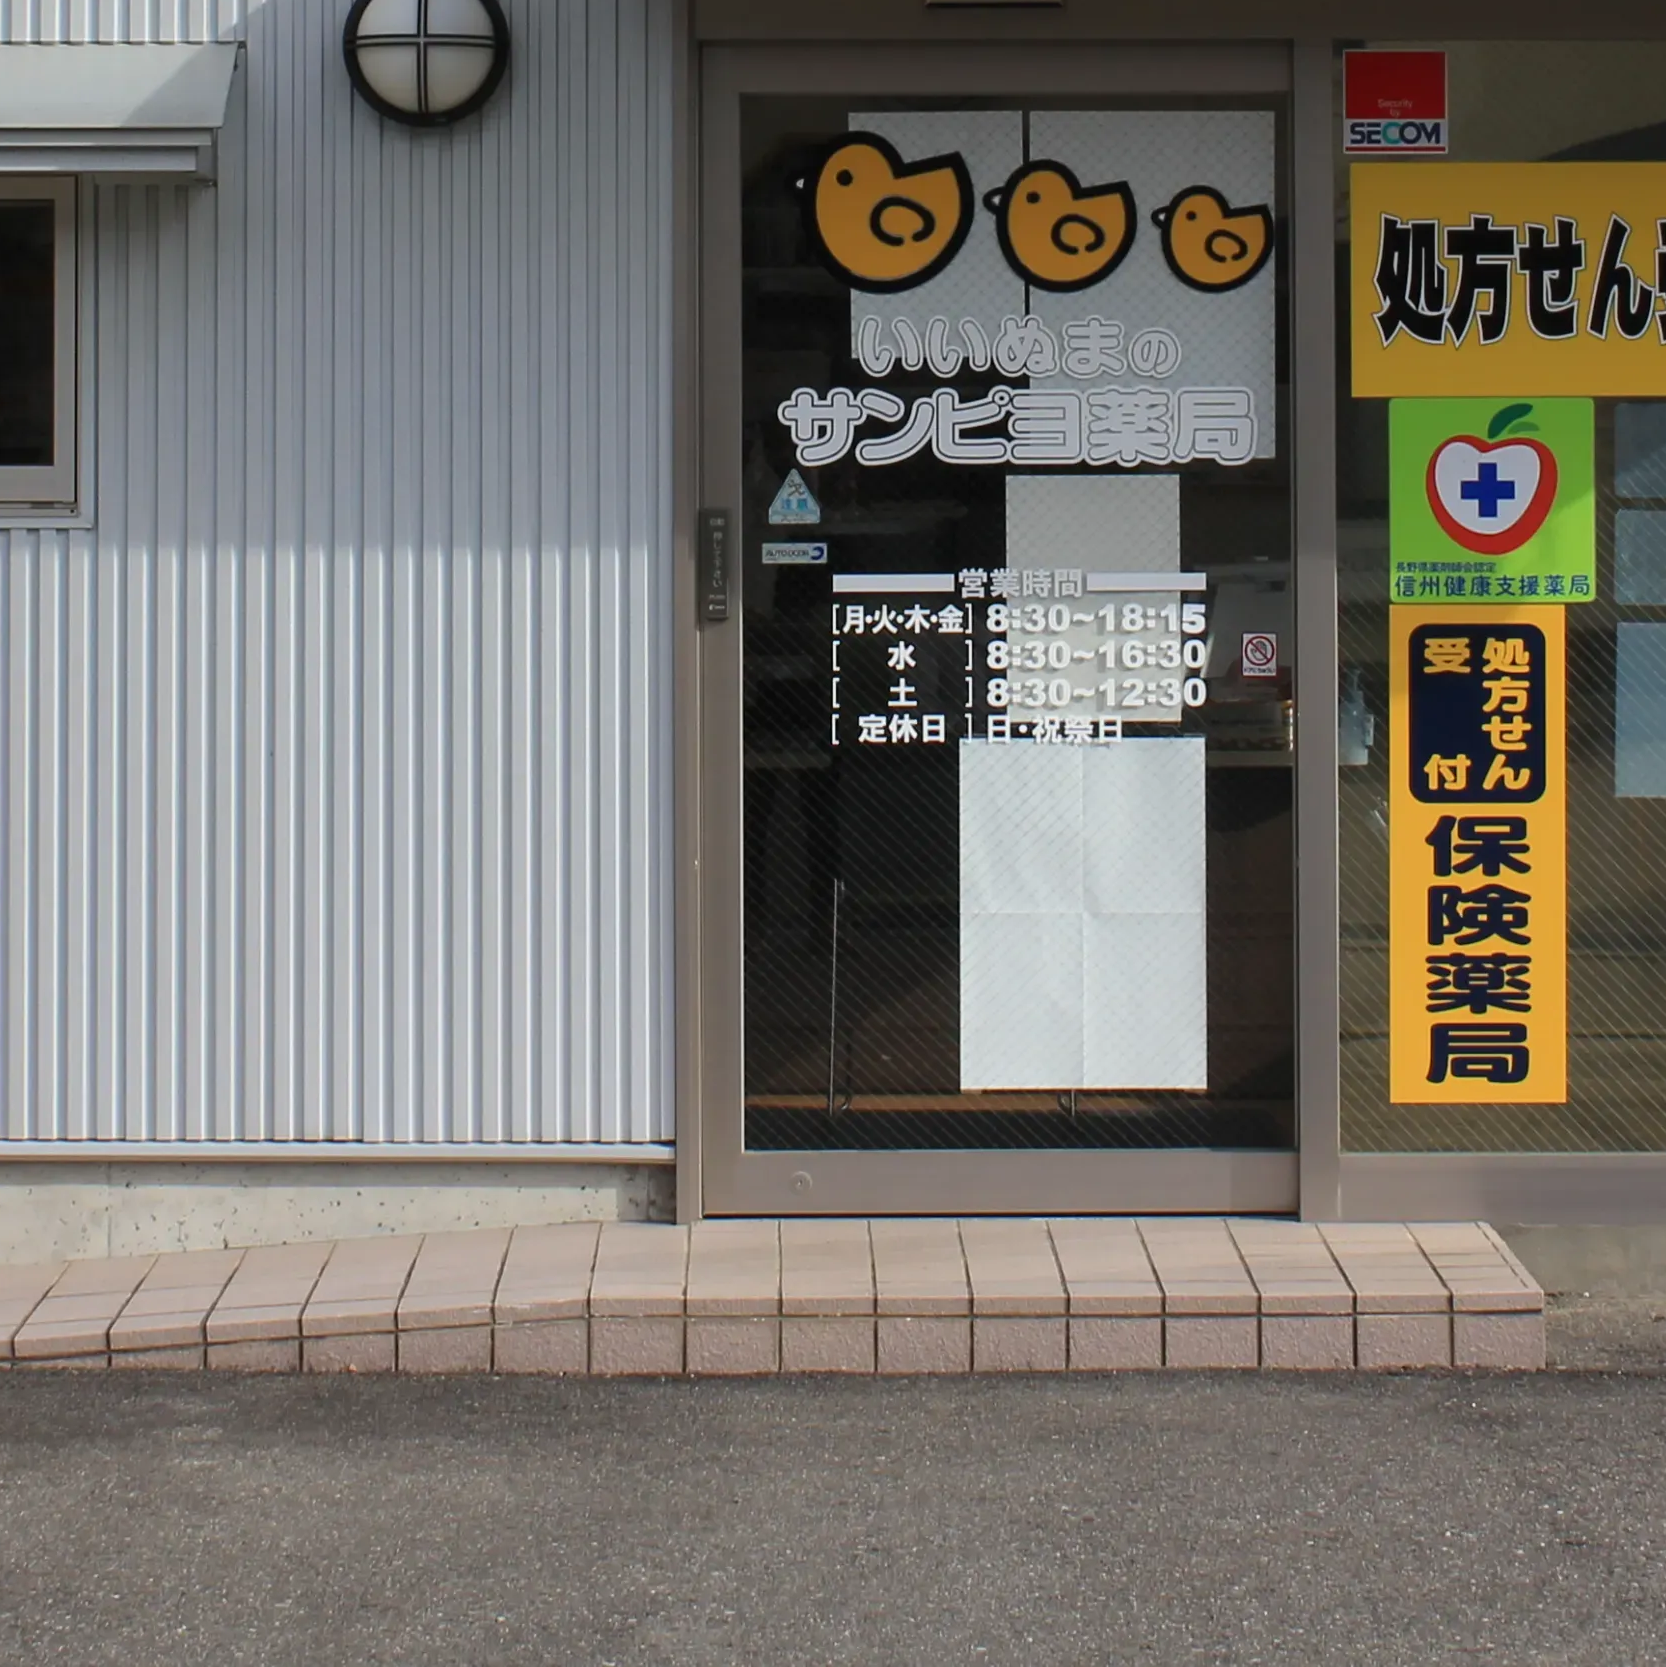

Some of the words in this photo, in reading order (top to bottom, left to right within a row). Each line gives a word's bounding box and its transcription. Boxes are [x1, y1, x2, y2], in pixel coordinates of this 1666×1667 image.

[1377, 99, 1413, 109] Security
[1389, 109, 1401, 119] by
[1350, 121, 1441, 145] SECOM
[859, 315, 1182, 378] いいぬまの
[778, 386, 1259, 467] サンピヨ薬局
[958, 568, 1084, 599] 営業時間
[1395, 575, 1591, 597] 信州健康支援薬局
[1481, 637, 1532, 791] 処方せん
[1424, 814, 1532, 1084] 保険薬局
